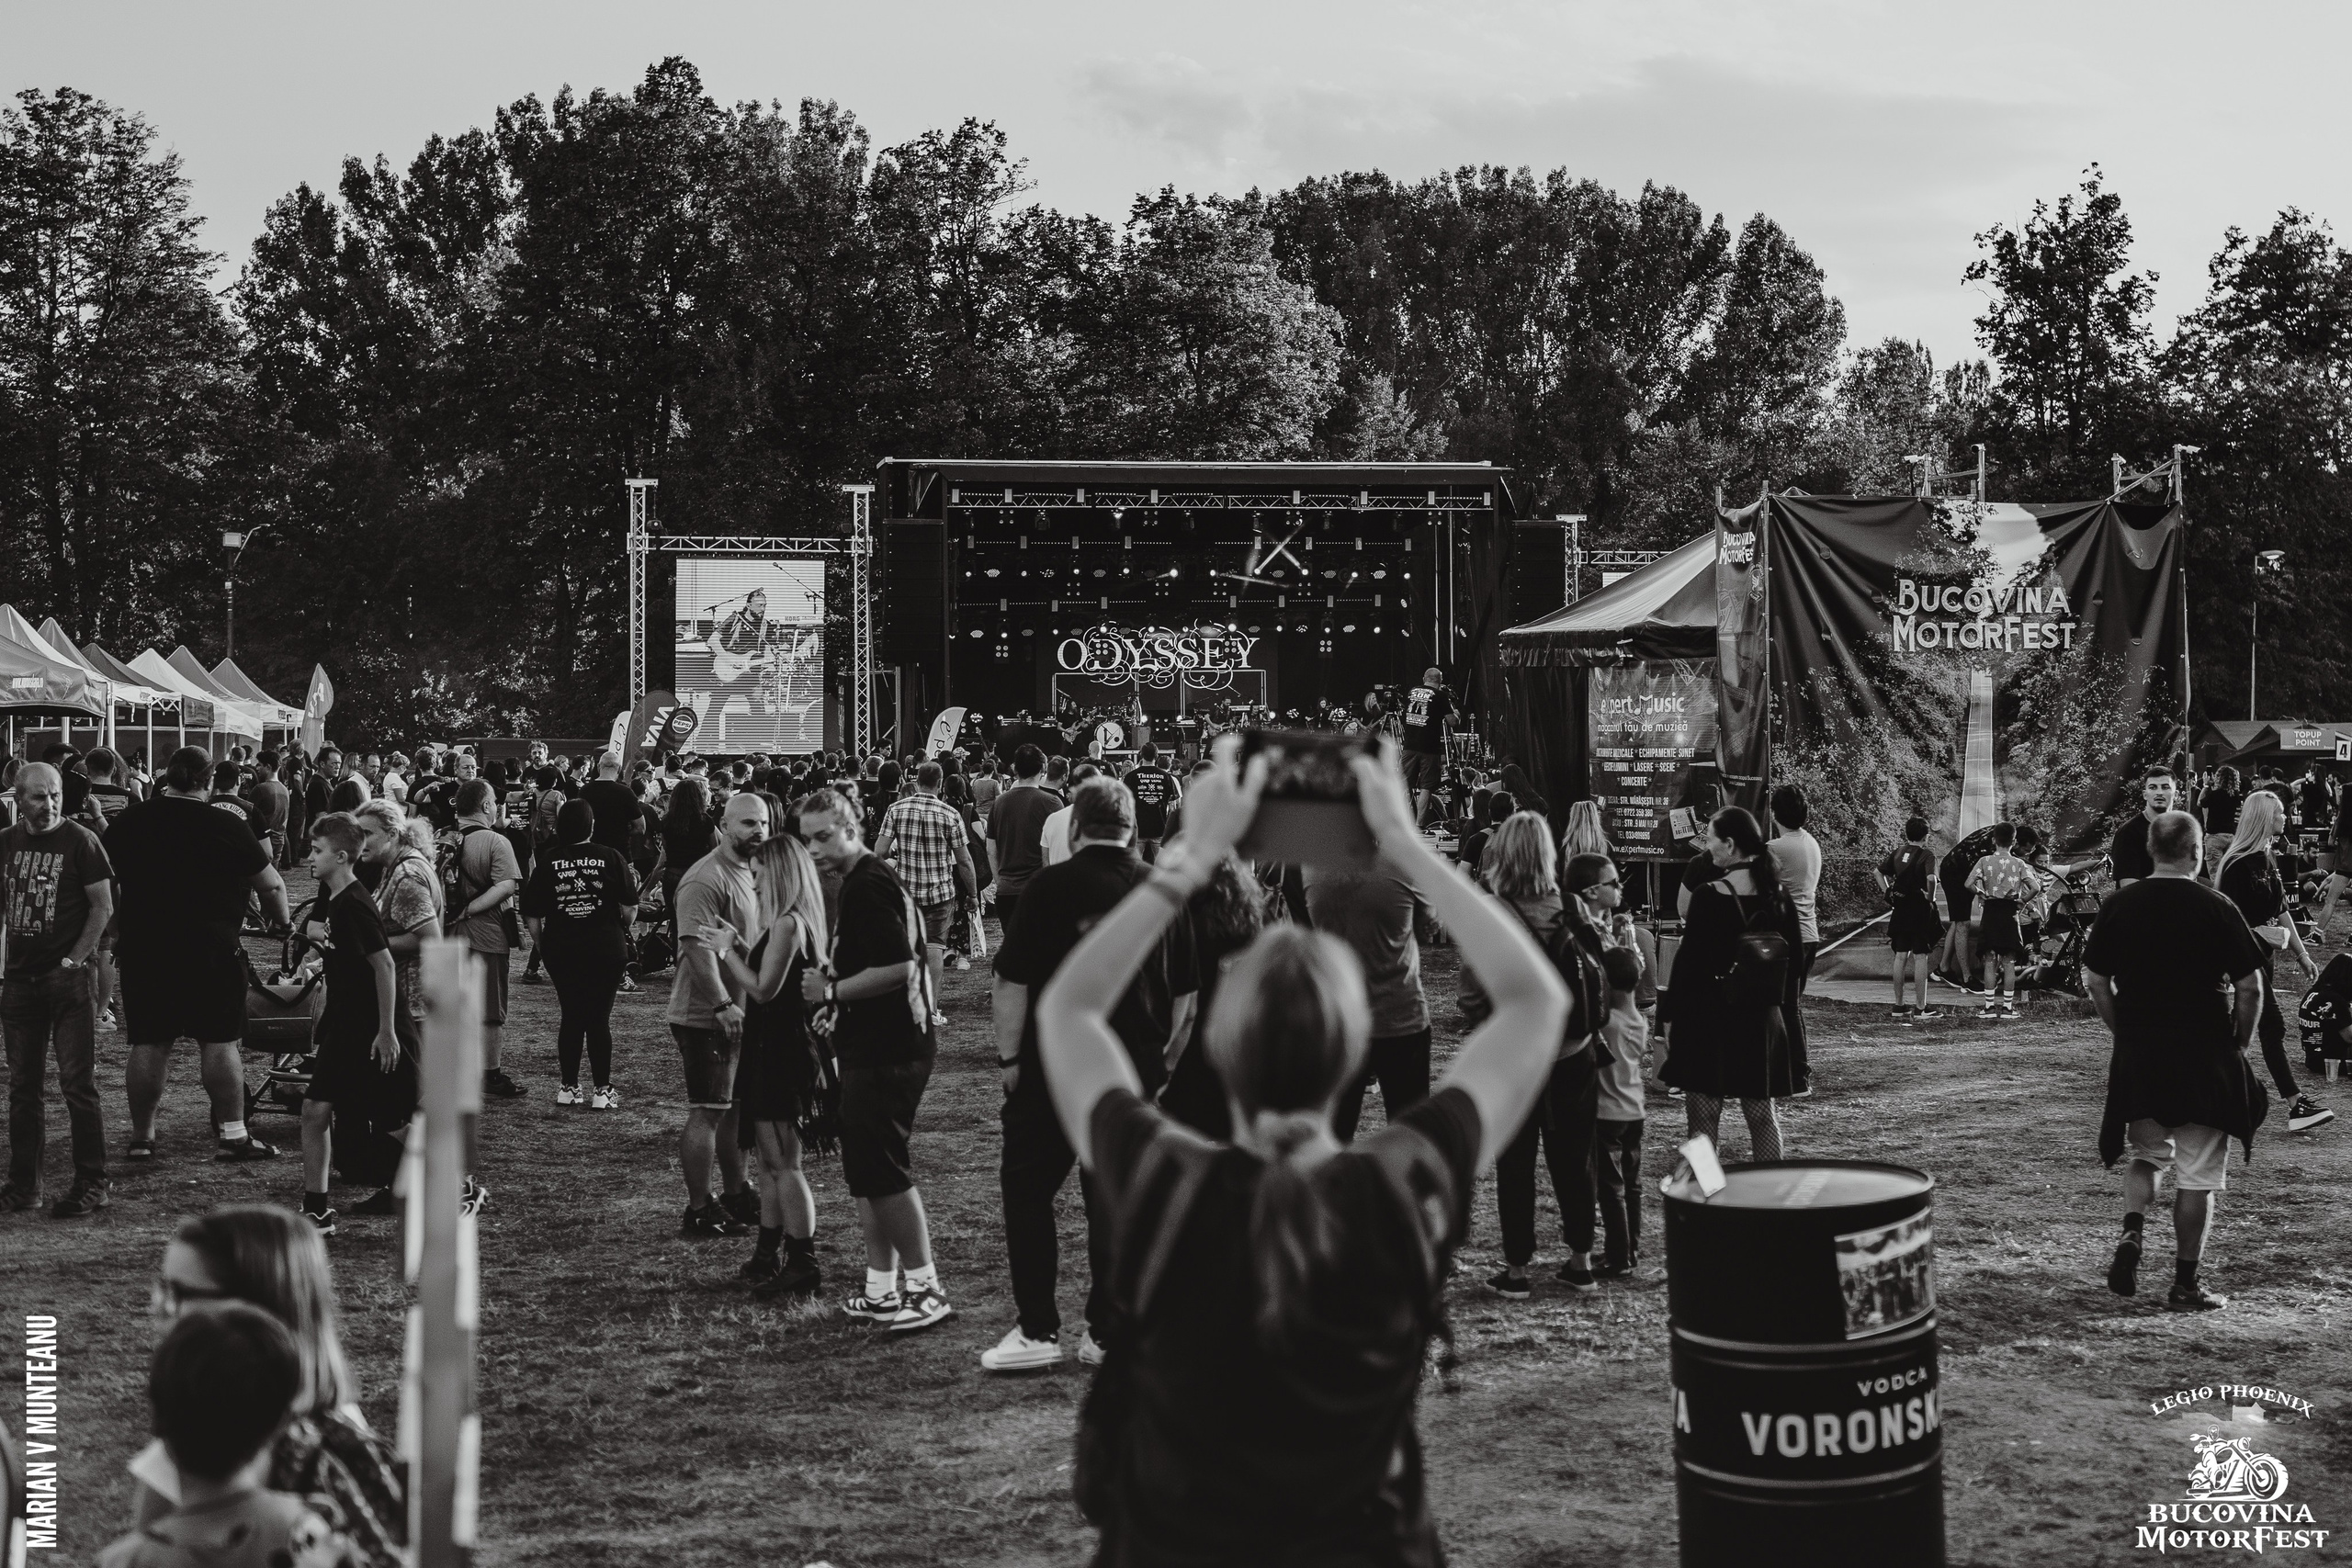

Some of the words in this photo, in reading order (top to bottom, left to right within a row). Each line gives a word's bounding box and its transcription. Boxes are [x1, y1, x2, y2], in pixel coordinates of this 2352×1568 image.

[1718, 547, 1754, 565] MOTORFES
[1898, 579, 2071, 615] BUCOVINA
[1057, 635, 1260, 673] ODYSSEY
[640, 706, 675, 747] VIVA
[673, 719, 692, 728] PEPSI
[1624, 721, 1638, 732] tău
[1641, 720, 1654, 732] de
[1656, 721, 1689, 732] muzică
[2295, 739, 2321, 747] POINT
[1639, 748, 1677, 758] ECHIPAMENTE
[1679, 748, 1695, 758] SUNET
[2339, 744, 2348, 759] 4
[1634, 762, 1654, 772] LASERE
[1621, 776, 1647, 786] CONCERTE
[1857, 1365, 1928, 1397] VODCA
